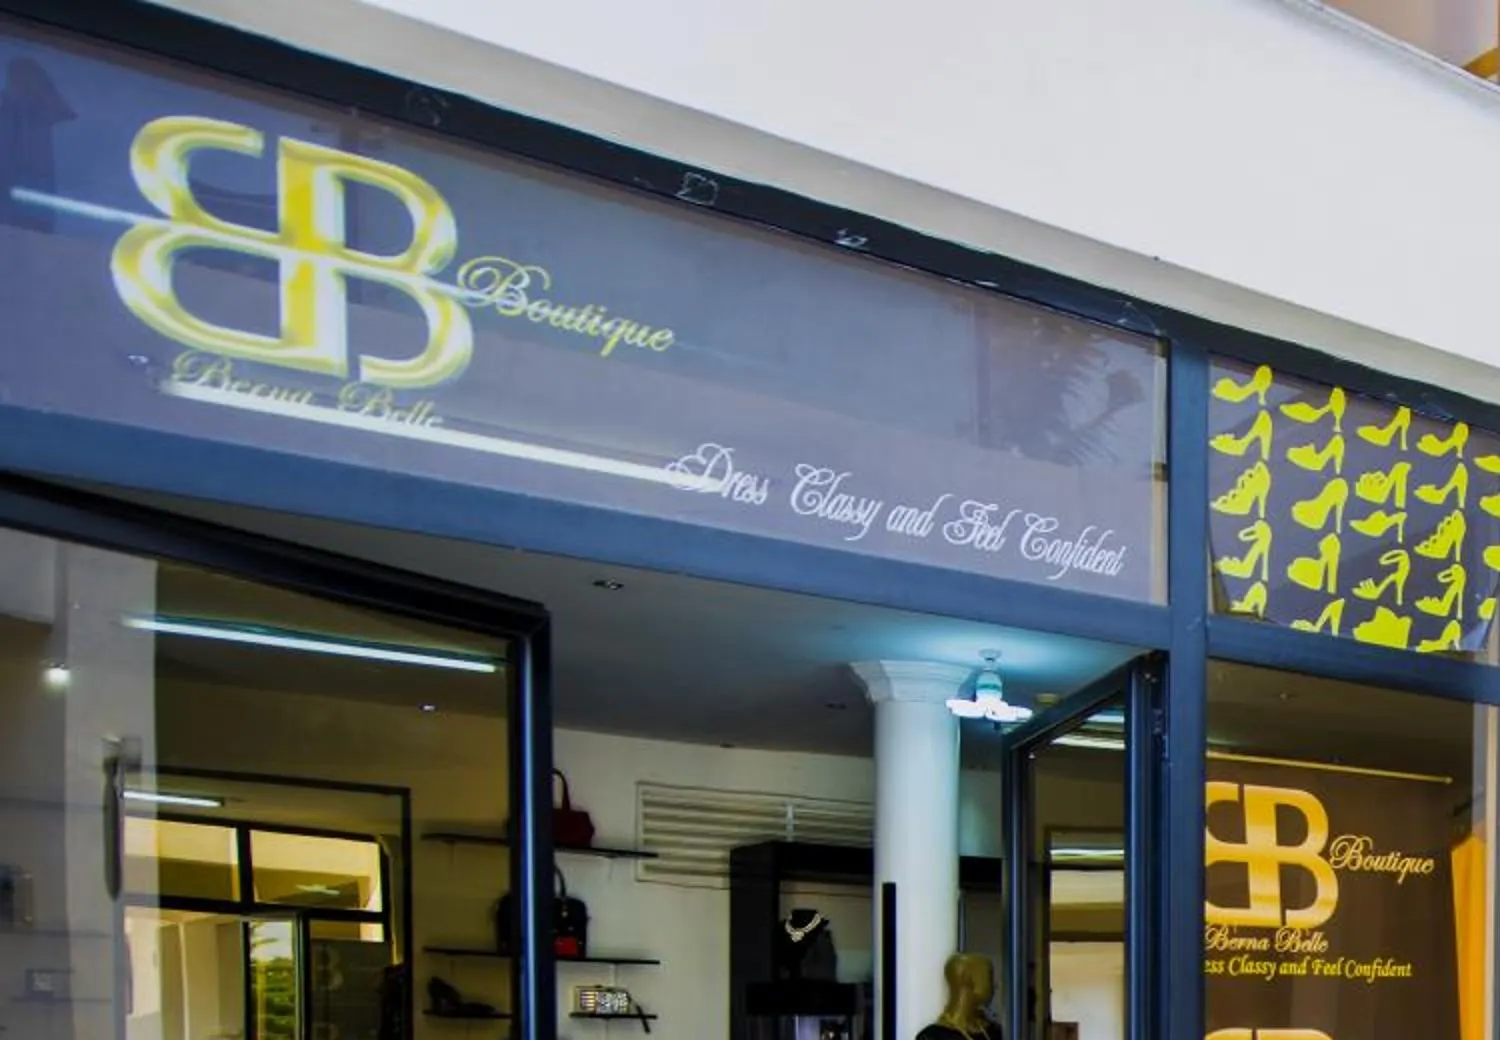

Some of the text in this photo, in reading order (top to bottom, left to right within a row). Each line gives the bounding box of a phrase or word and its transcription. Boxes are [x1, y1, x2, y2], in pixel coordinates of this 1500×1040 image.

[457, 256, 674, 357] Boutique
[664, 442, 768, 505] Dress
[790, 463, 884, 541] Classy
[886, 493, 953, 538] and
[1020, 512, 1127, 580] Confident
[1330, 834, 1434, 885] Boutique
[1204, 925, 1329, 953] Berna Belle
[1204, 955, 1412, 983] ess Classy and Feel Confident
